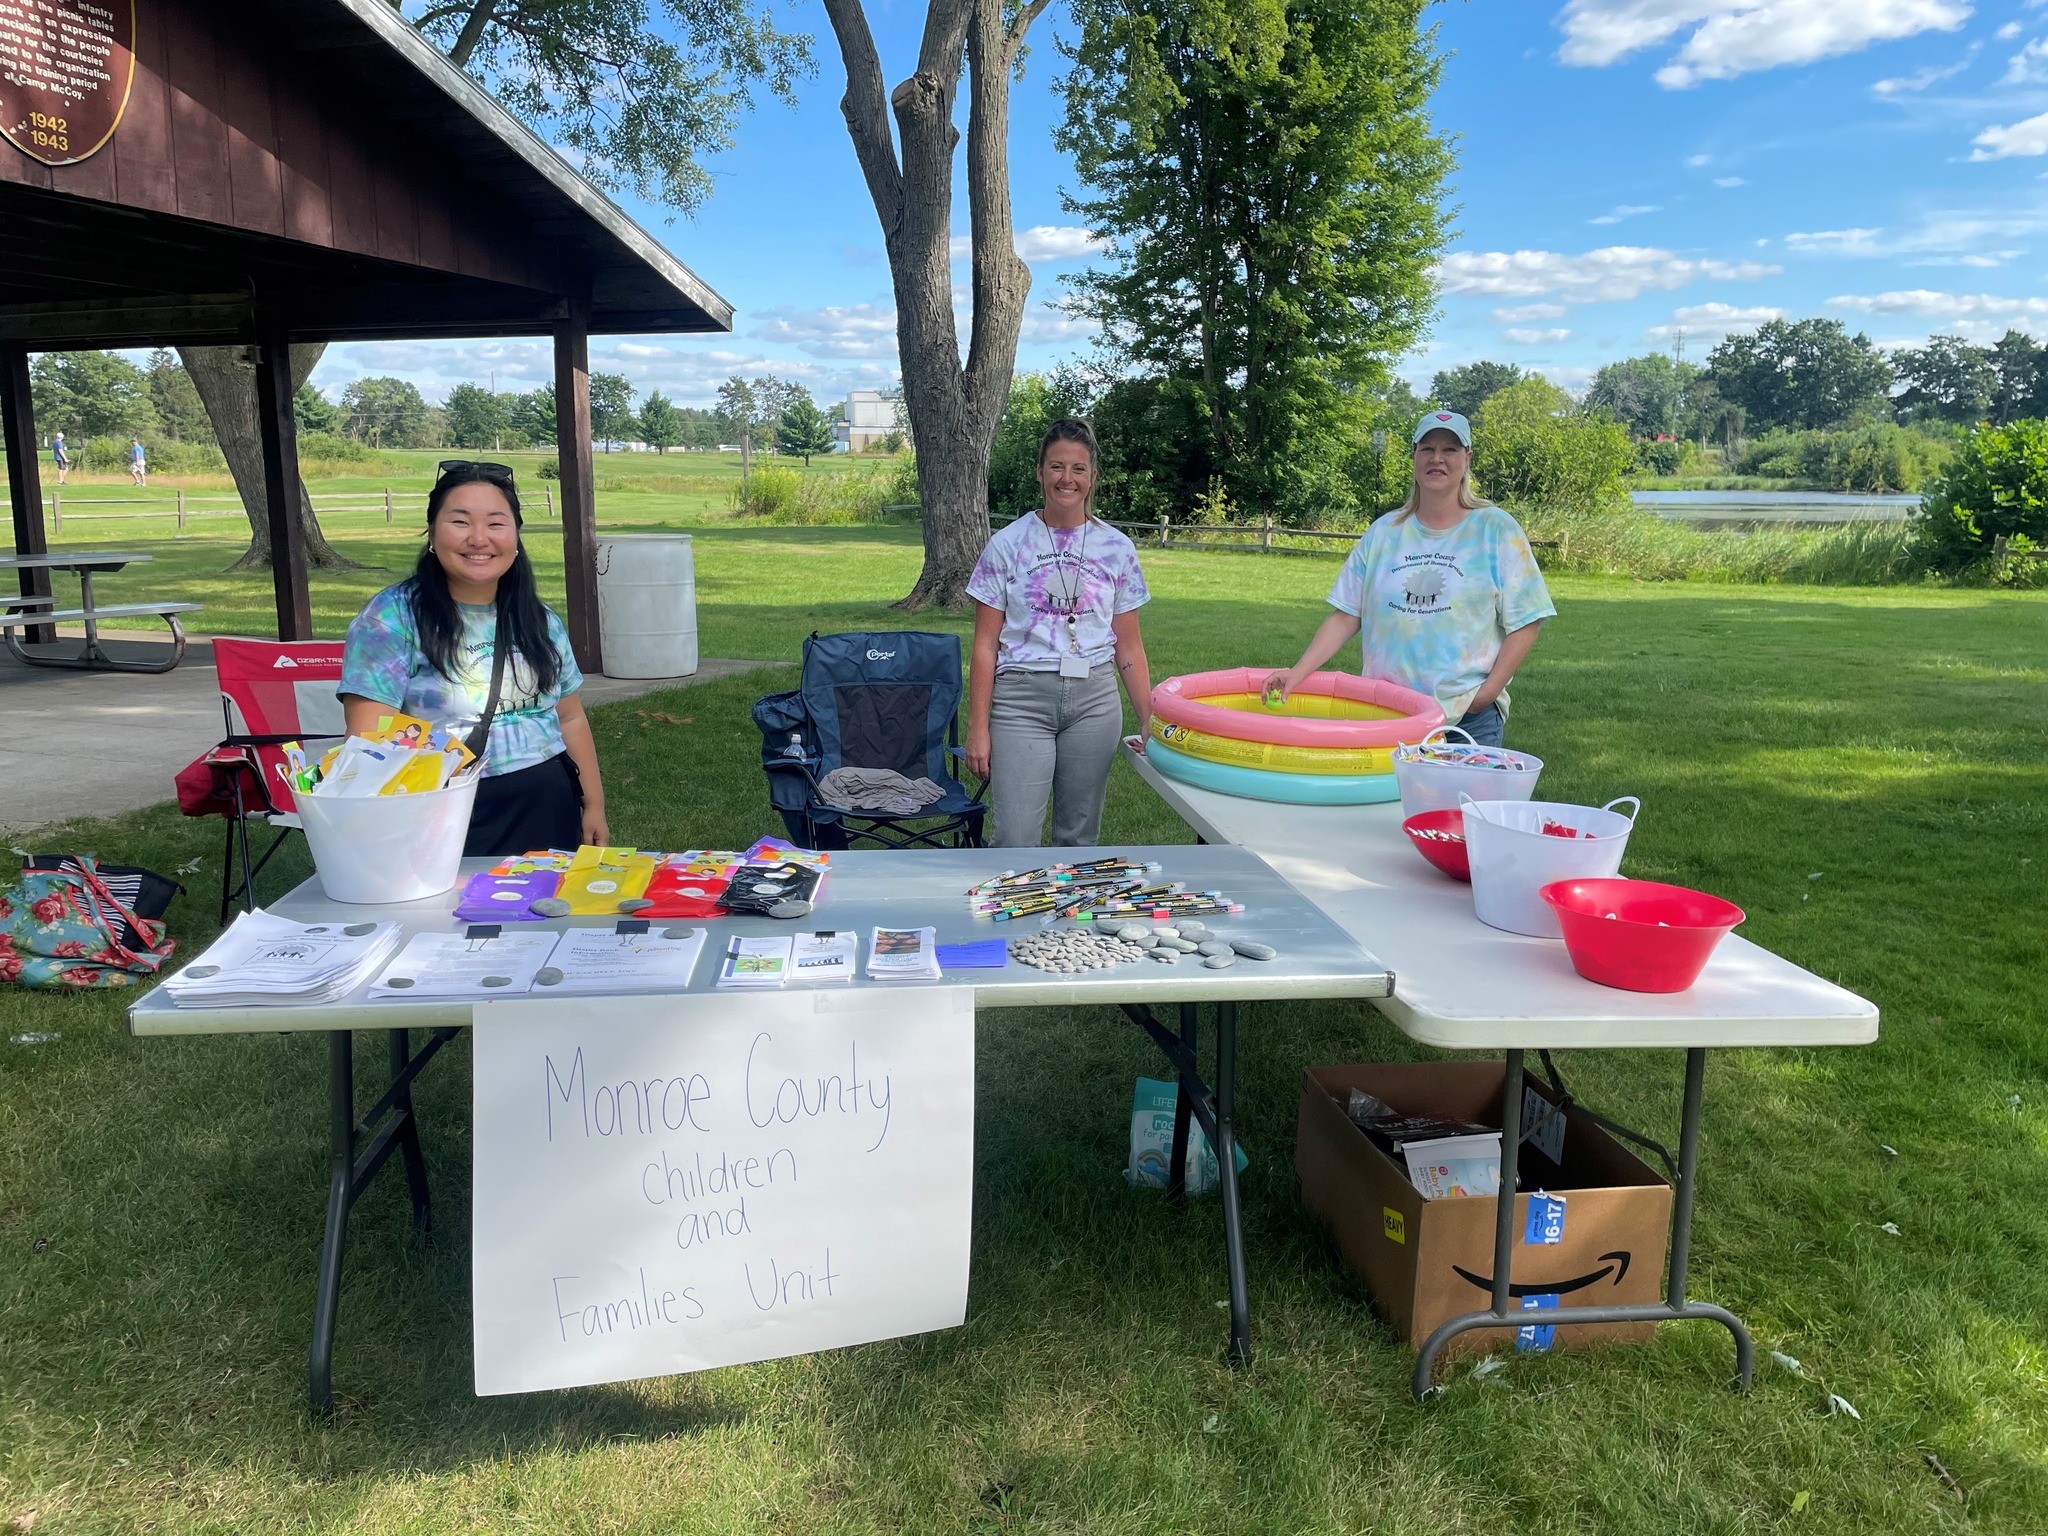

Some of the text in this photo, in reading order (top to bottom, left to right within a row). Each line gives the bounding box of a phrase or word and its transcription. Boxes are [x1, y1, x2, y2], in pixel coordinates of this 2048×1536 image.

[37, 1, 53, 14] the
[57, 8, 84, 23] picnic
[88, 16, 115, 32] tables
[78, 0, 113, 21] infantry
[0, 3, 113, 45] park as an expression
[24, 36, 39, 49] for
[41, 41, 57, 54] the
[60, 48, 103, 67] courtesies
[46, 30, 57, 41] to
[60, 33, 76, 47] the
[80, 41, 110, 57] people
[19, 60, 32, 73] its
[35, 65, 68, 84] training
[21, 48, 33, 60] to
[35, 52, 52, 66] the
[56, 60, 111, 81] organization
[4, 71, 86, 100] at Camp McCoy.
[29, 111, 68, 134] 1942
[30, 129, 69, 152] 1943
[1026, 560, 1054, 576] Department
[1036, 552, 1062, 562] Monroe
[1391, 561, 1423, 574] Department
[1405, 553, 1456, 562] Monroe County
[1388, 601, 1407, 613] Caring
[1417, 605, 1452, 615] Generations
[545, 1031, 893, 1153] Monroe County
[1152, 1096, 1177, 1109] LIFET
[1143, 1129, 1158, 1139] for
[1154, 1119, 1175, 1131] roc
[1429, 1165, 1440, 1188] Baby
[677, 1196, 752, 1250] and
[1384, 1214, 1403, 1235] HEAVY
[1544, 1202, 1562, 1244] 16-17
[552, 1247, 841, 1343] Families Unit
